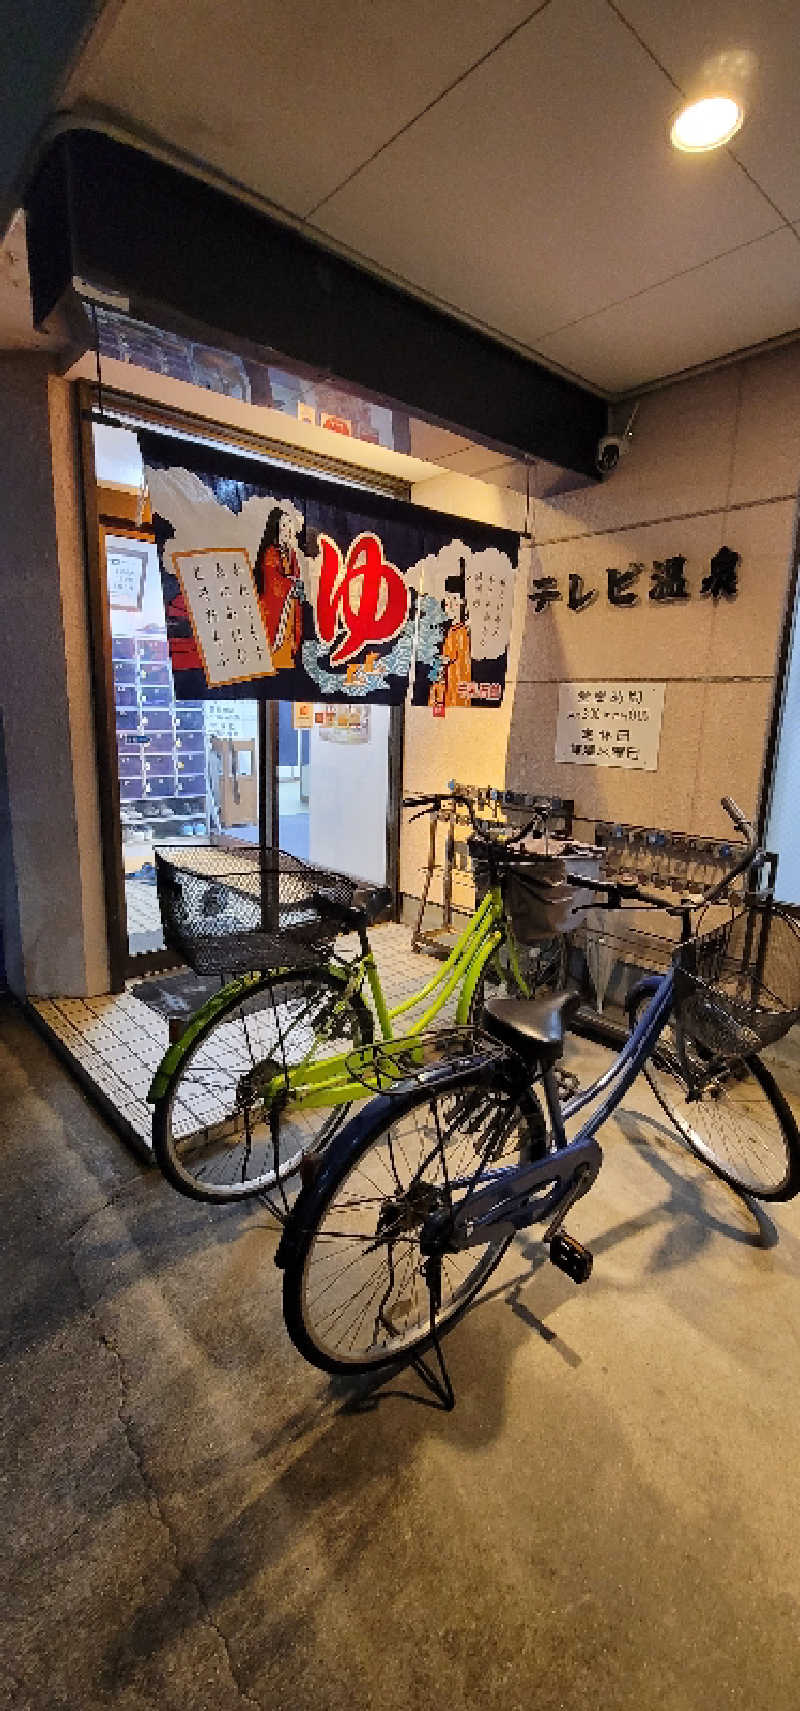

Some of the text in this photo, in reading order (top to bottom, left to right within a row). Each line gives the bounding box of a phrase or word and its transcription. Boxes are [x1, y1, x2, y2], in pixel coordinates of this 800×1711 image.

[314, 532, 411, 668] ゆ
[528, 546, 741, 614] テレビ温泉
[581, 728, 630, 742] 定休日
